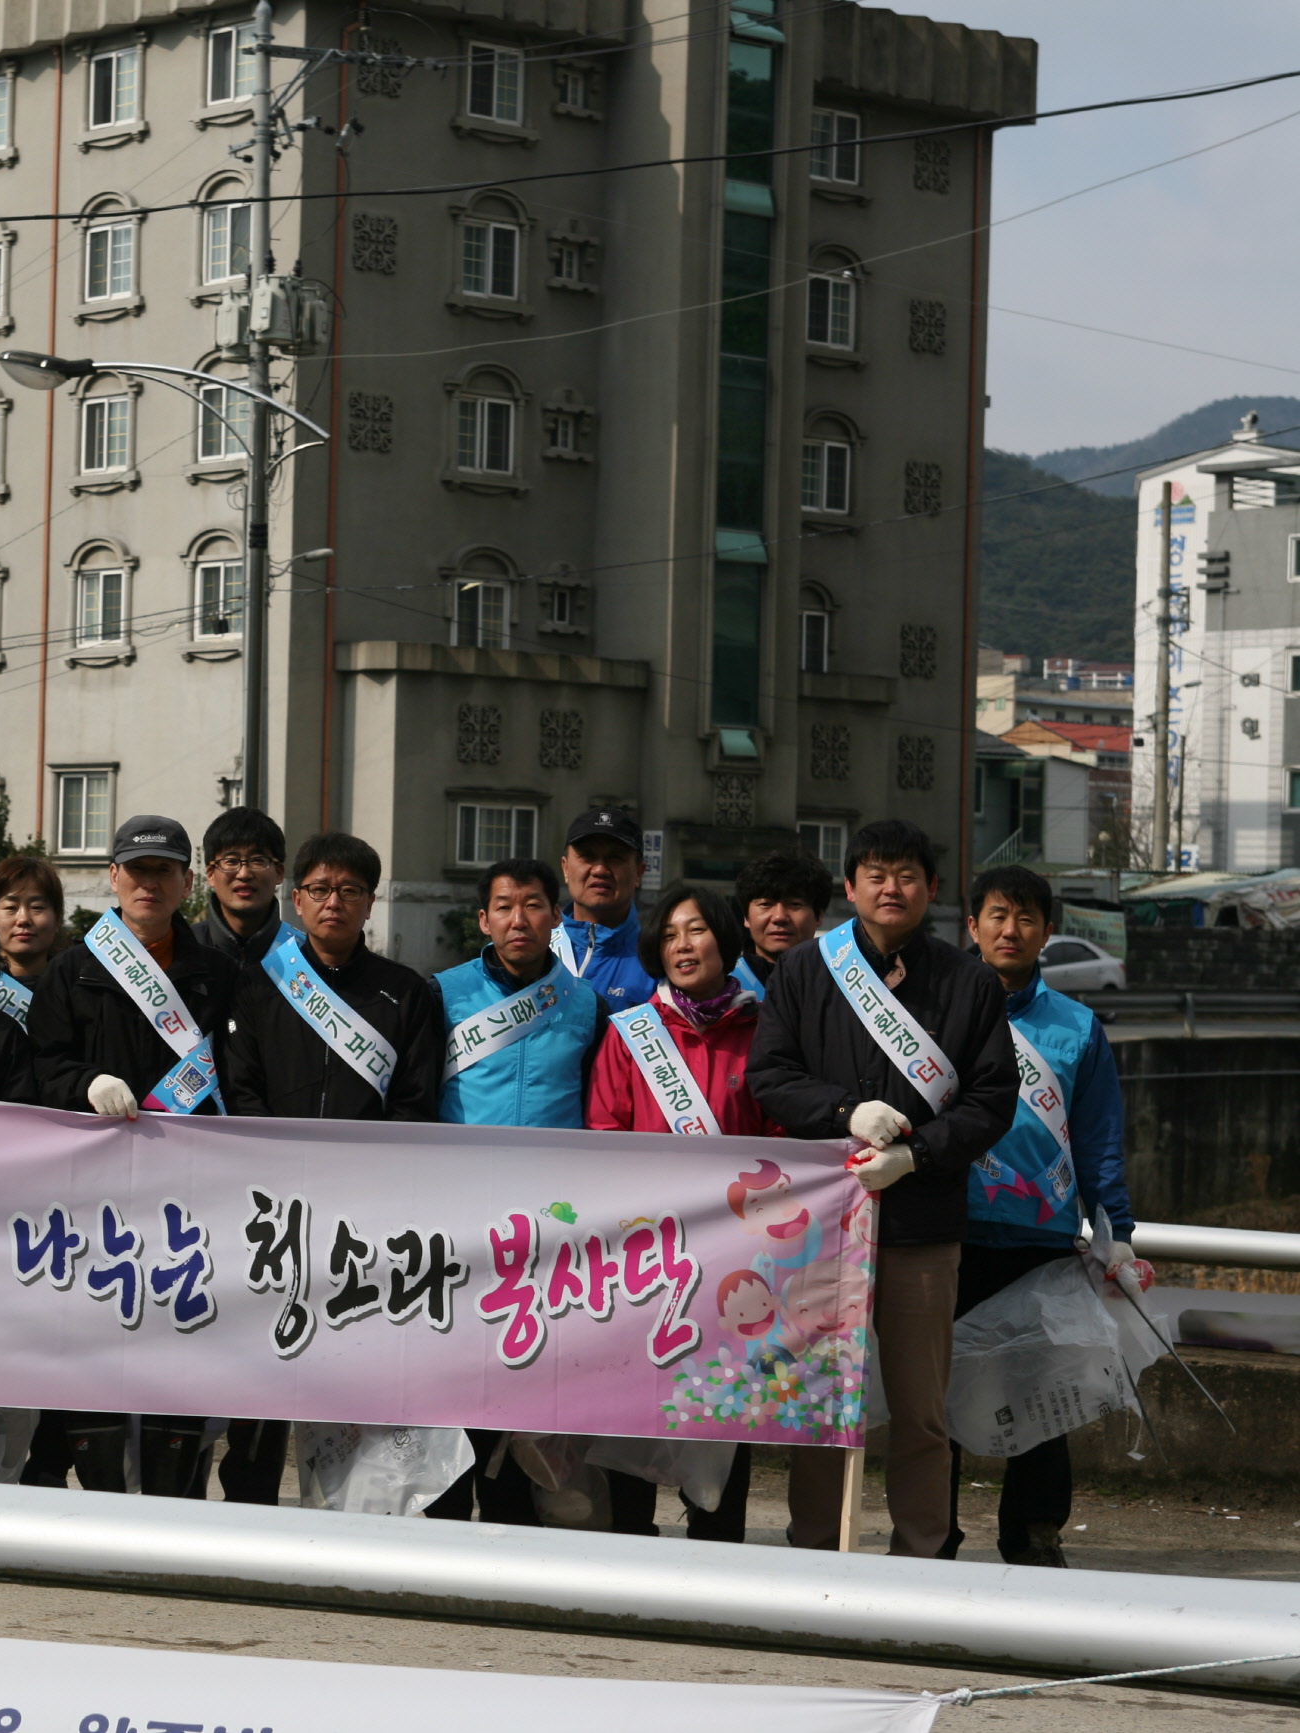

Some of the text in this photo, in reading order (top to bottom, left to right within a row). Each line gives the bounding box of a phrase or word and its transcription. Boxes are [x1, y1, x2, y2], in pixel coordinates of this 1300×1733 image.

[94, 923, 188, 1035] 우리환경 더
[844, 966, 945, 1084] 우리환경 더
[306, 991, 392, 1077] 줍기보다
[446, 994, 538, 1067] 줍기보다
[627, 1016, 694, 1112] 우리환경
[1038, 1086, 1061, 1113] 더
[12, 1202, 209, 1321] 나누는
[243, 1190, 460, 1349] 청소과
[478, 1213, 695, 1361] 봉사단
